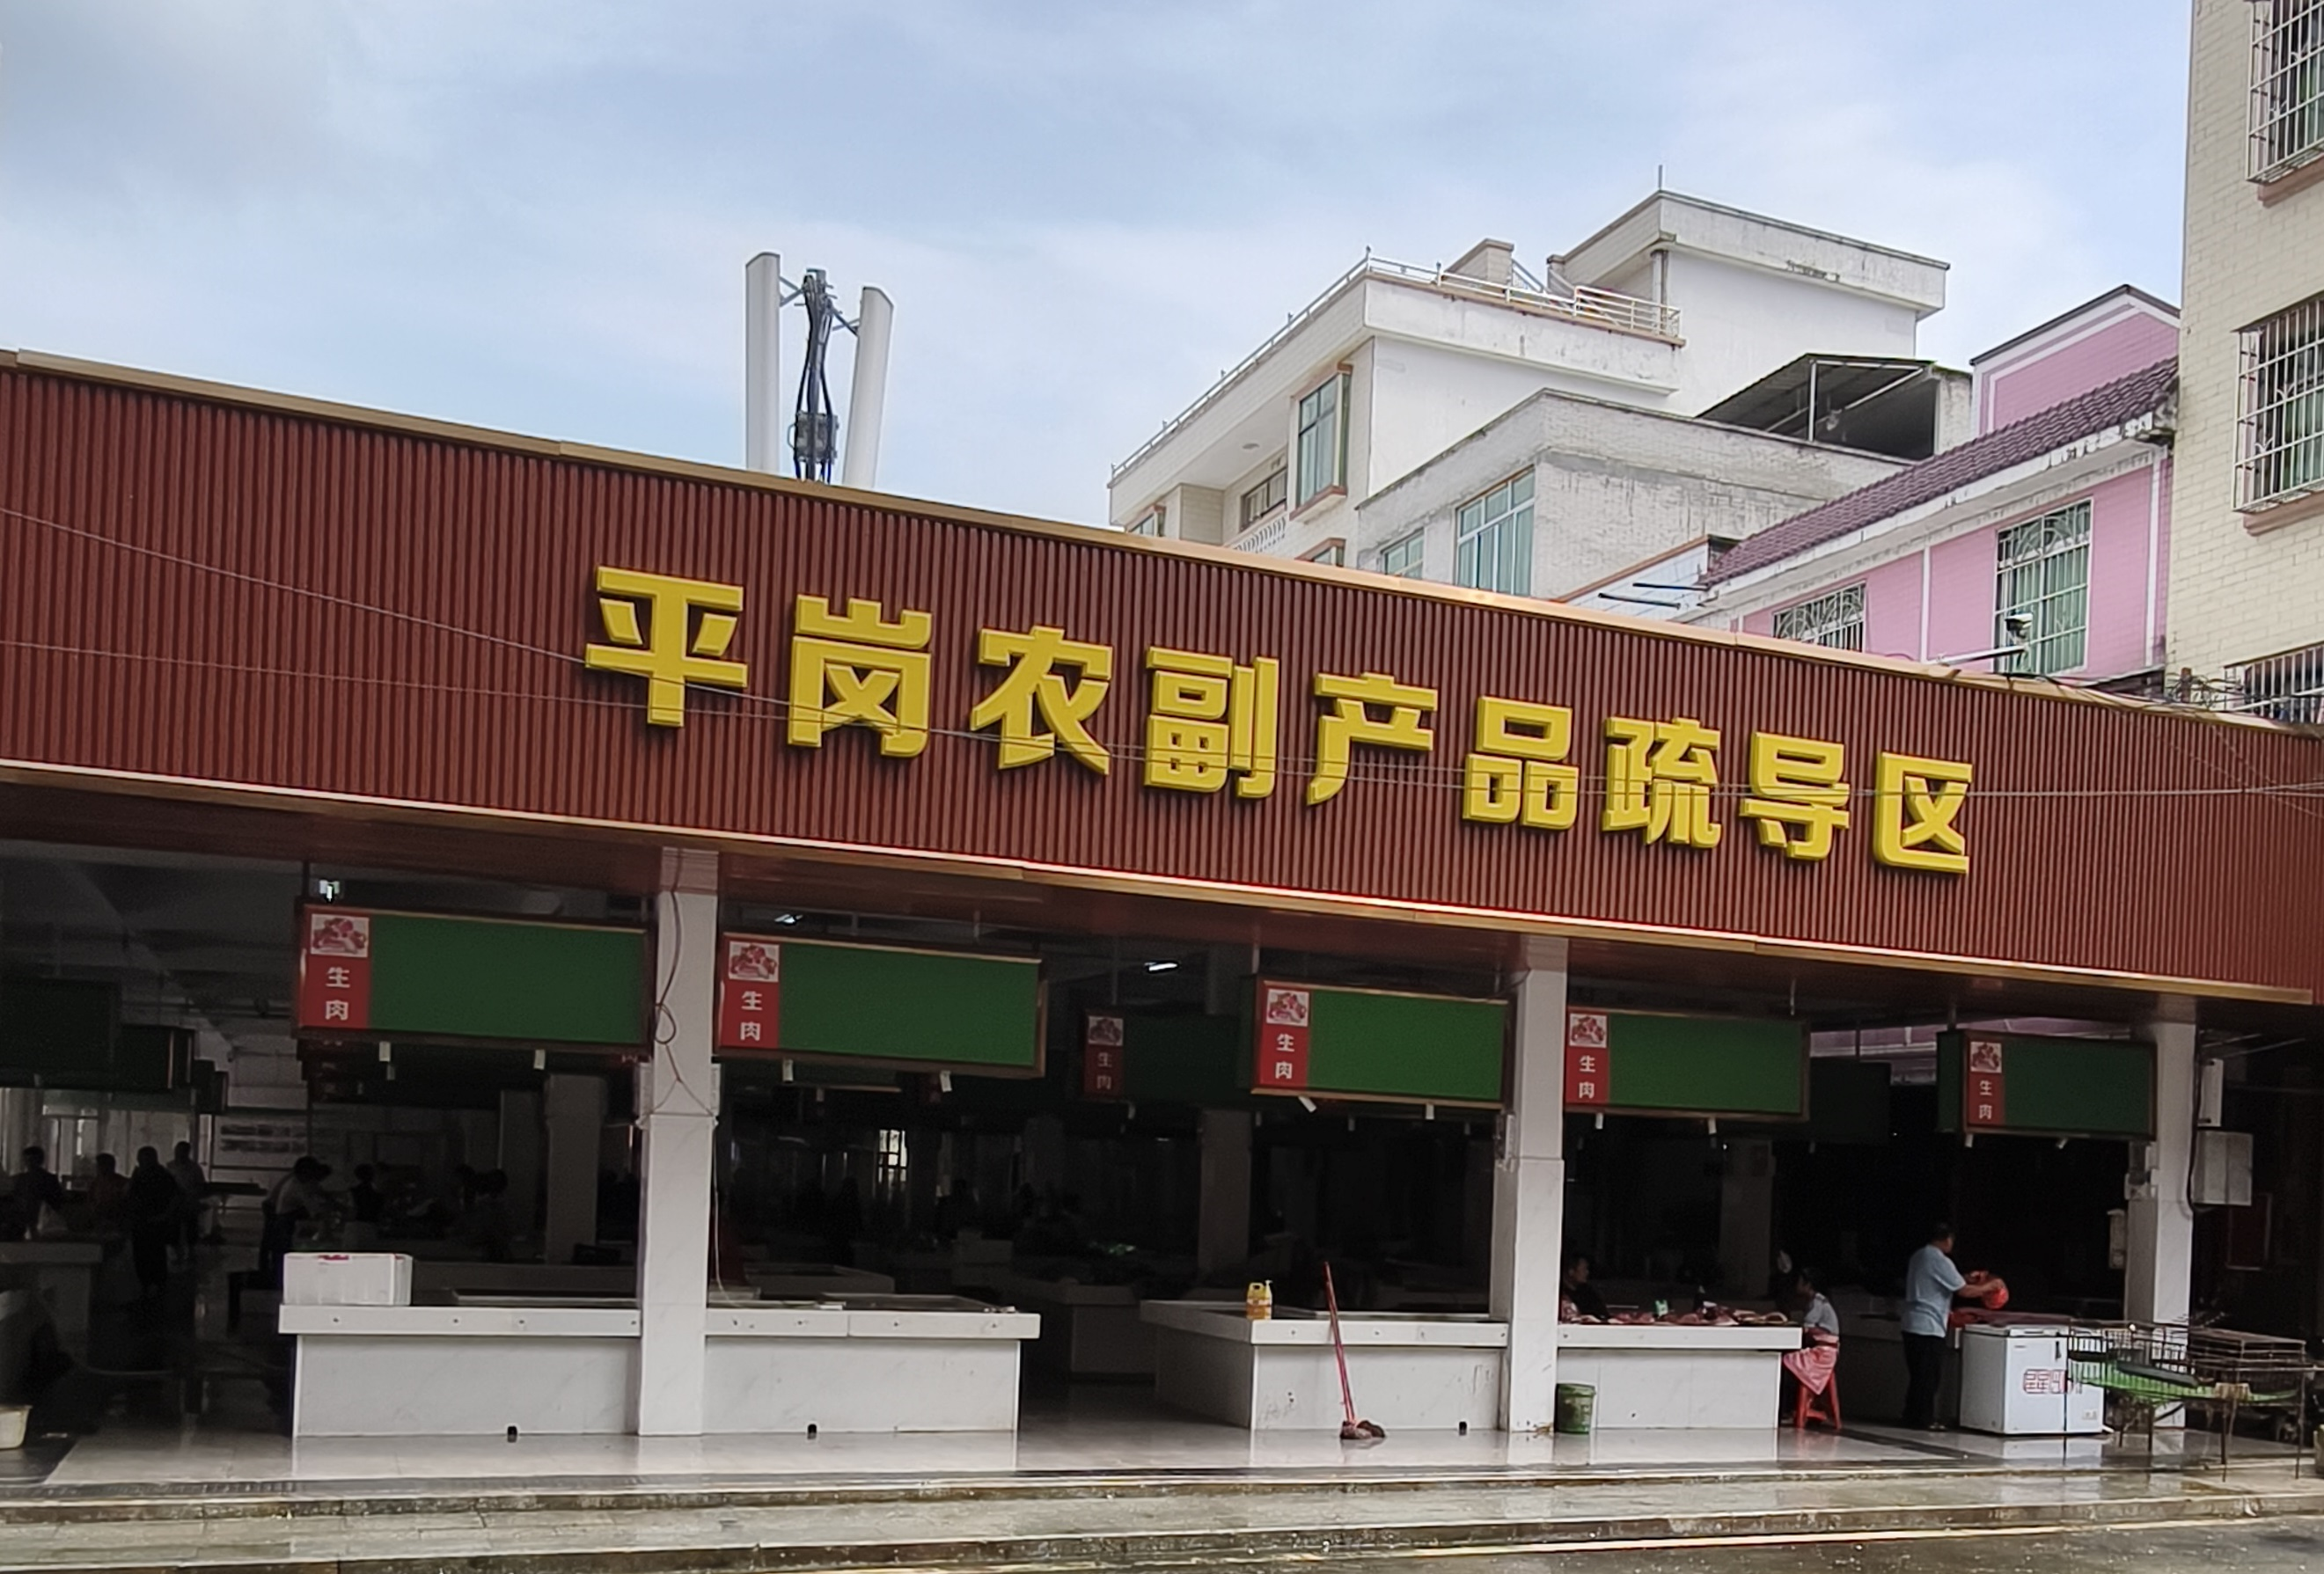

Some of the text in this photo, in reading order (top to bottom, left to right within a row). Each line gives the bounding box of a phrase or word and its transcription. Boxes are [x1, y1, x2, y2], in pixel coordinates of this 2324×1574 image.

[584, 566, 1972, 874] 平岗农副产品疏导区
[325, 966, 350, 1021] 生肉
[740, 991, 763, 1041] 生肉
[1275, 1033, 1295, 1080] 生肉
[1579, 1055, 1596, 1099] 生肉
[1978, 1080, 1993, 1120] 生肉
